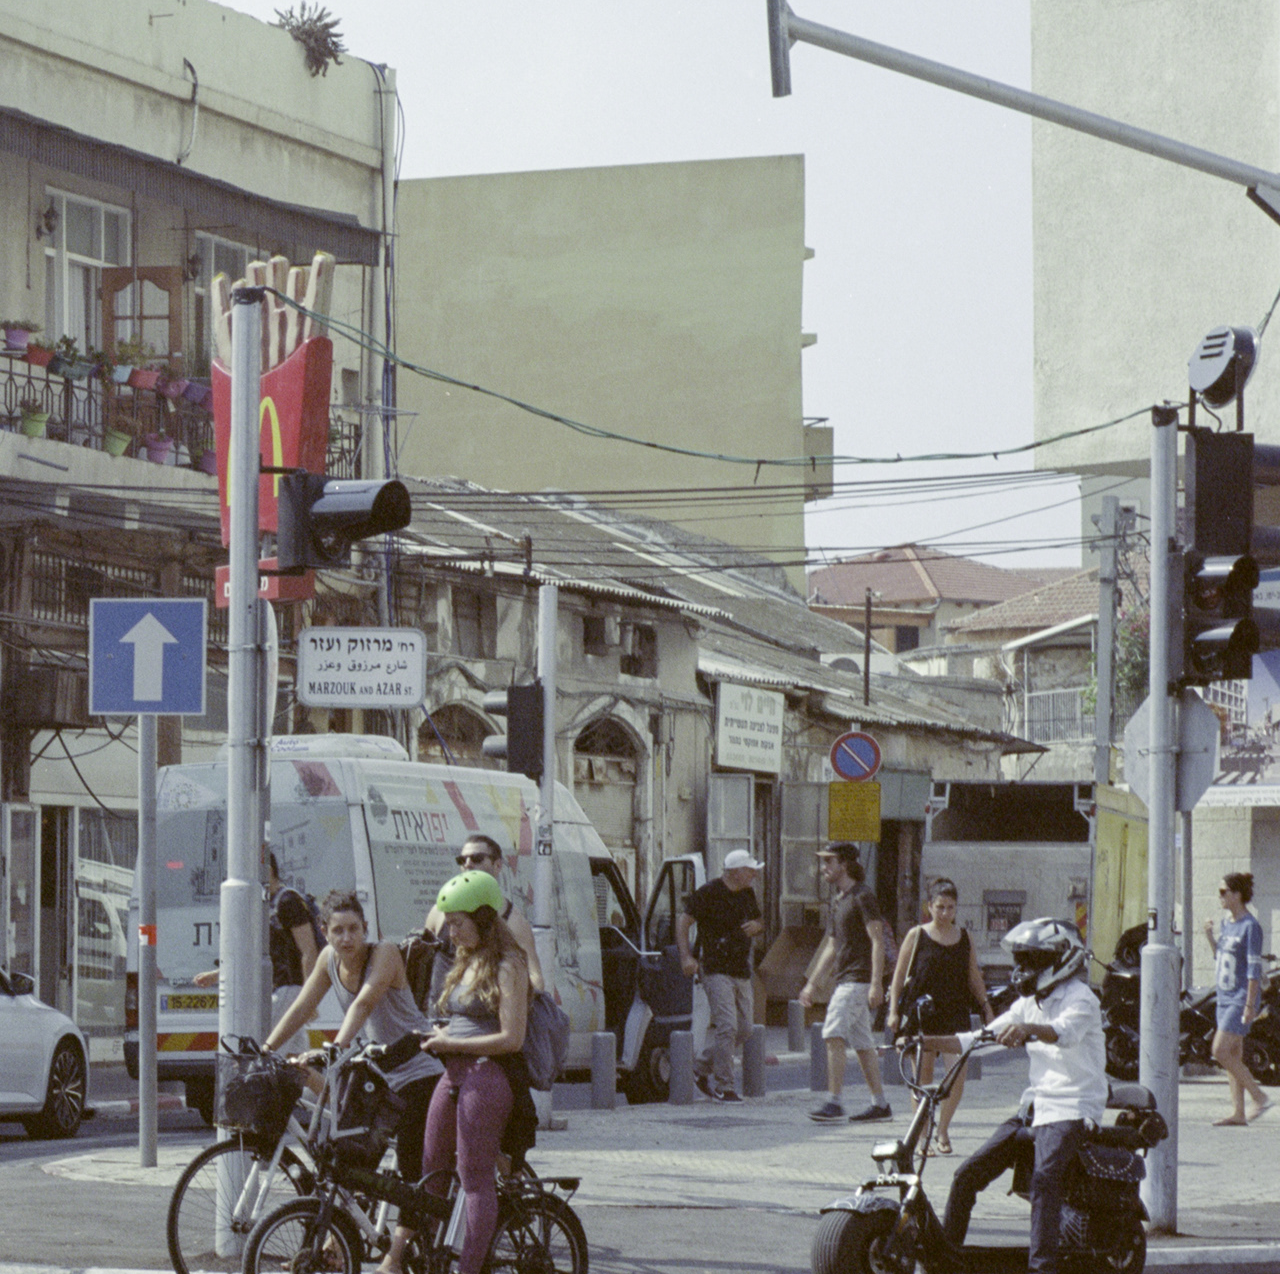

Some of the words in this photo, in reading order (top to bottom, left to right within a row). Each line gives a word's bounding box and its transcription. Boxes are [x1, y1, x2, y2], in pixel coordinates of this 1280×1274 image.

[309, 637, 342, 652] ועזר
[348, 637, 393, 655] מרזוק
[347, 660, 381, 672] مرزوق
[386, 660, 408, 675] شارع
[308, 682, 357, 695] MARZOUK
[360, 686, 374, 695] AND
[376, 682, 402, 695] AZAR
[391, 809, 449, 843] יפואית
